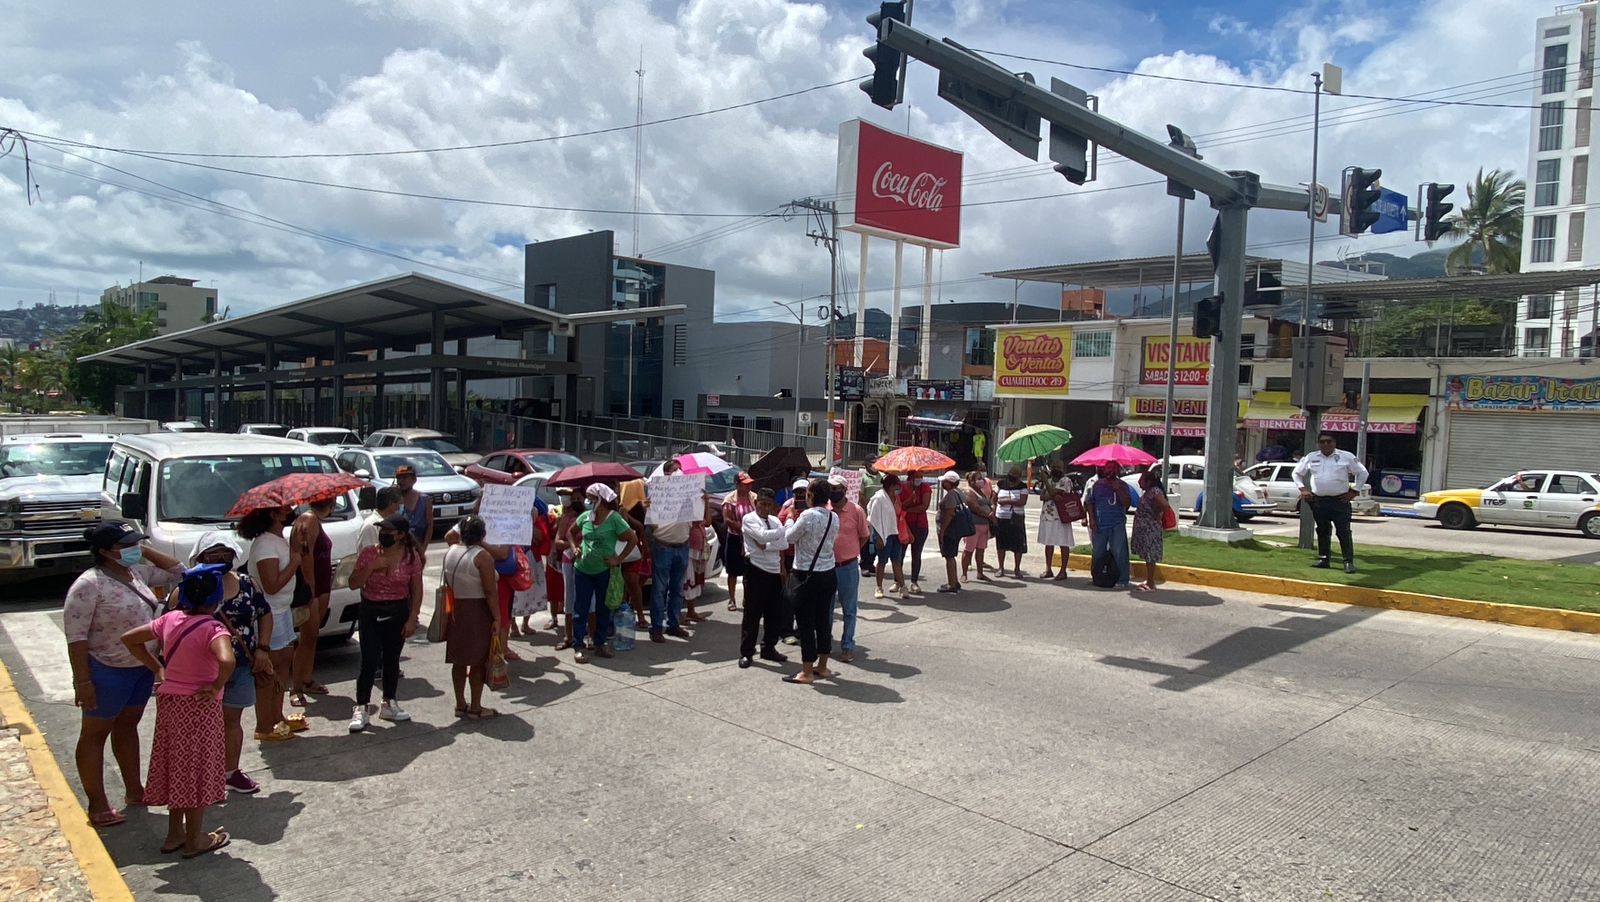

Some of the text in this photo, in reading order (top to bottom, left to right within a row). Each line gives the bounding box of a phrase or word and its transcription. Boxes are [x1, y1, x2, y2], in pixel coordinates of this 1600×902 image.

[872, 161, 947, 212] Coca Cola
[1004, 335, 1062, 357] Ventas
[1148, 343, 1211, 363] VISTAN
[1020, 356, 1063, 372] Ventas
[1001, 376, 1048, 386] CUAUHTEMOC
[1145, 370, 1180, 382] SABADS
[1180, 370, 1200, 382] 12:00
[1467, 377, 1537, 400] Bazar
[1127, 427, 1175, 436] BIENVENIDS
[1184, 429, 1194, 437] SU
[1259, 420, 1397, 433] BIENVENIS A SU AZAR
[1483, 498, 1507, 506] 1765
